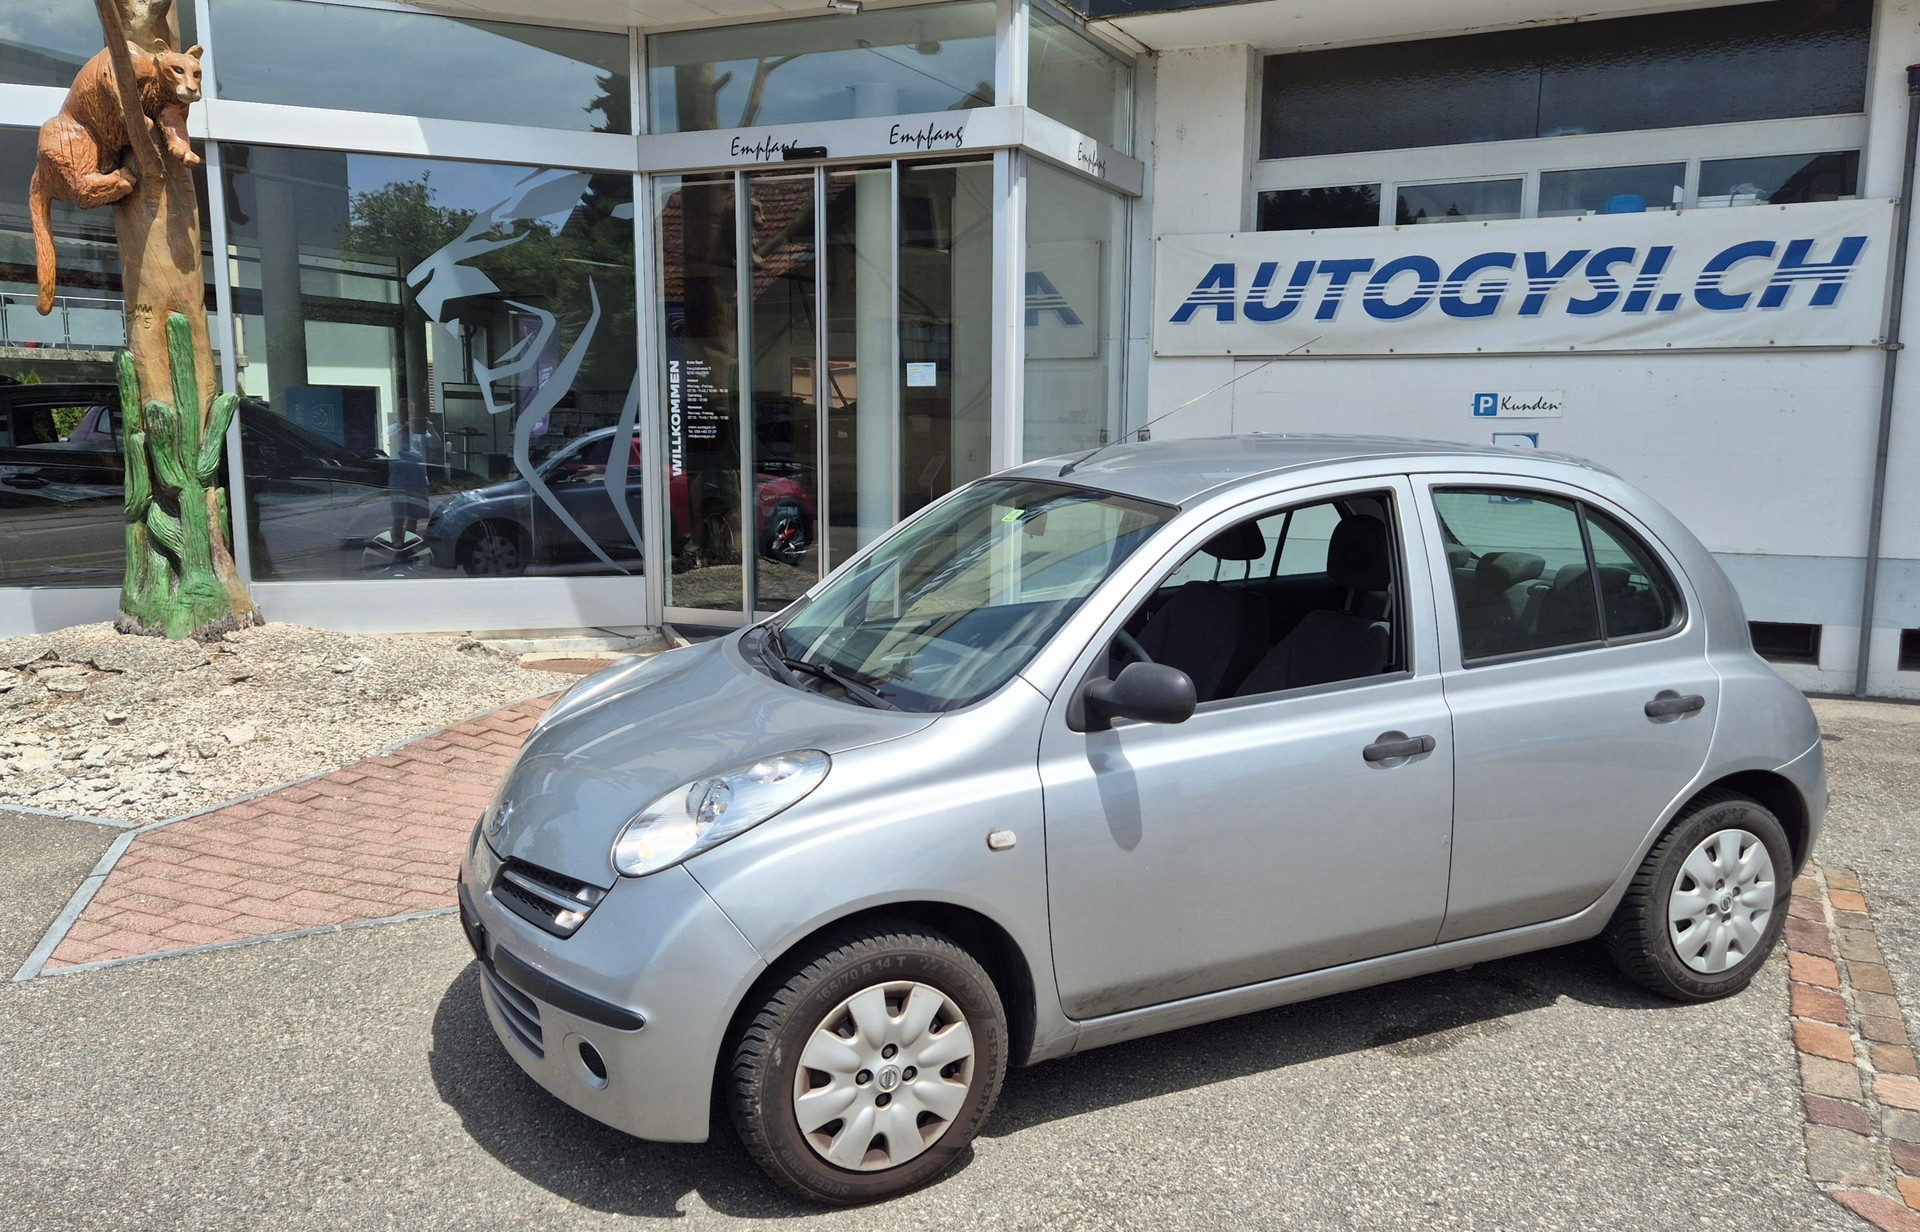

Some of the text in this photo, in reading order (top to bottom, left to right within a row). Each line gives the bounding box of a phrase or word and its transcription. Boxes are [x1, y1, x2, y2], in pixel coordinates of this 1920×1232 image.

[889, 122, 964, 150] Empfang
[1169, 236, 1869, 325] AUTOGYSI.CH
[669, 360, 682, 477] WILLKOMMEN
[1479, 395, 1558, 414] P Kunden
[816, 956, 906, 1001] 165/70 R 14 T
[970, 1026, 999, 1128] SEMPERIT
